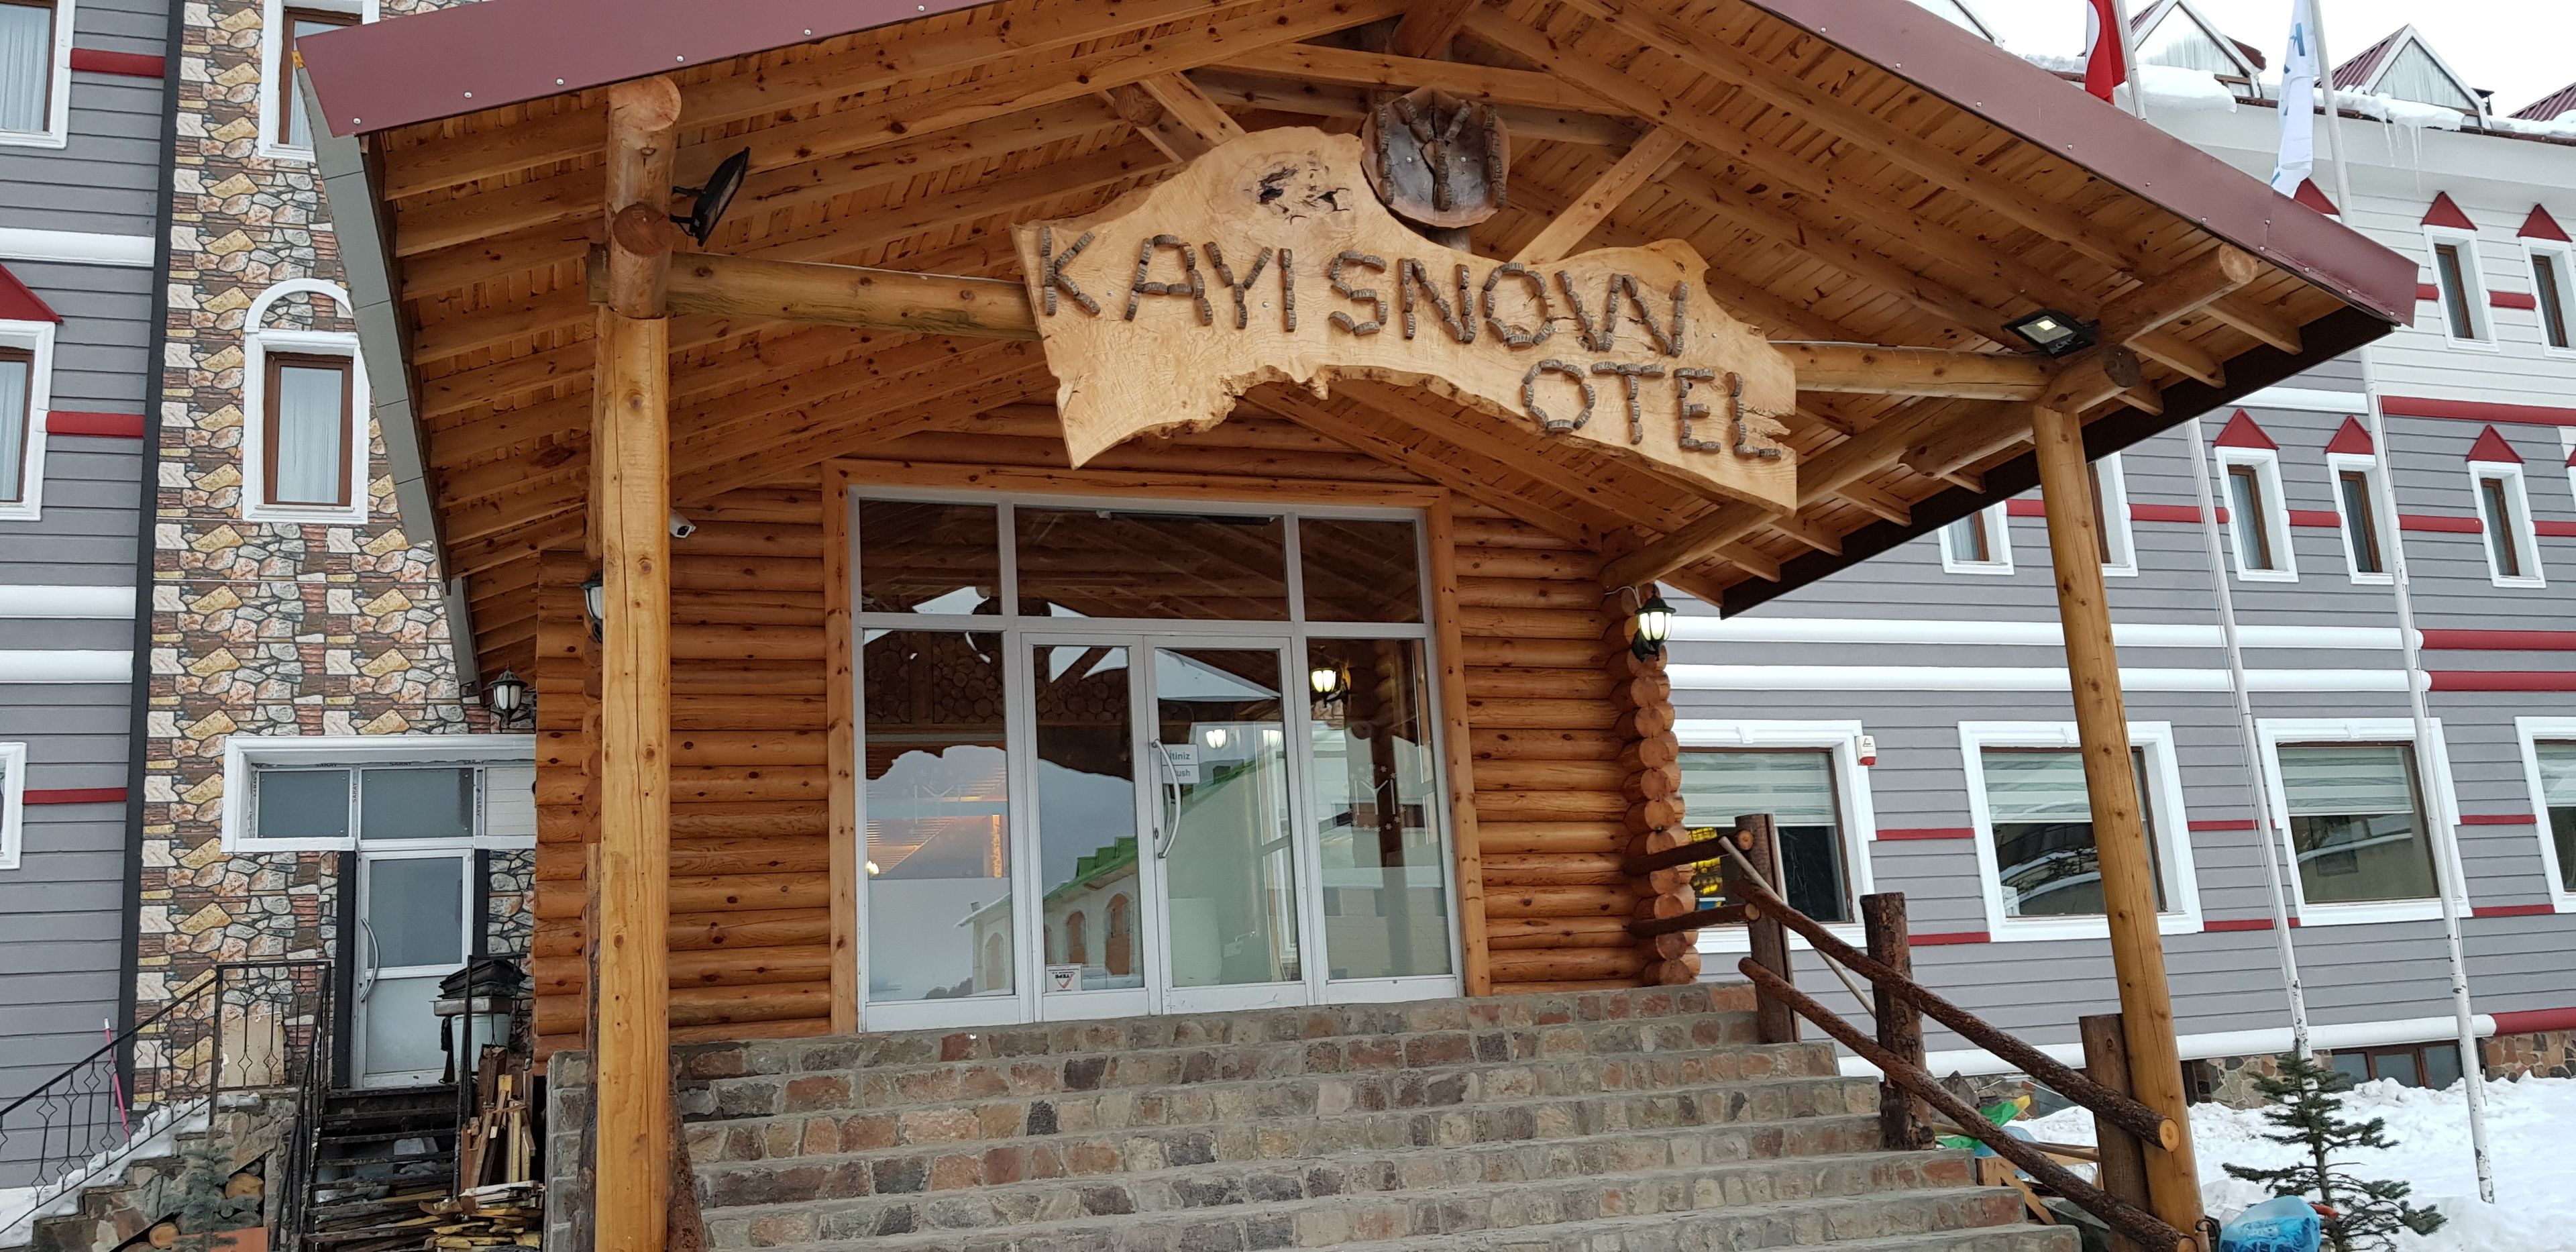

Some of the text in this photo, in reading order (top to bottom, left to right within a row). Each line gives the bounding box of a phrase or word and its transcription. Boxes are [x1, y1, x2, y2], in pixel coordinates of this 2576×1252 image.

[1039, 225, 1688, 357] KAYI SNOW
[1521, 359, 1782, 462] OTEL
[1176, 769, 1191, 777] ush
